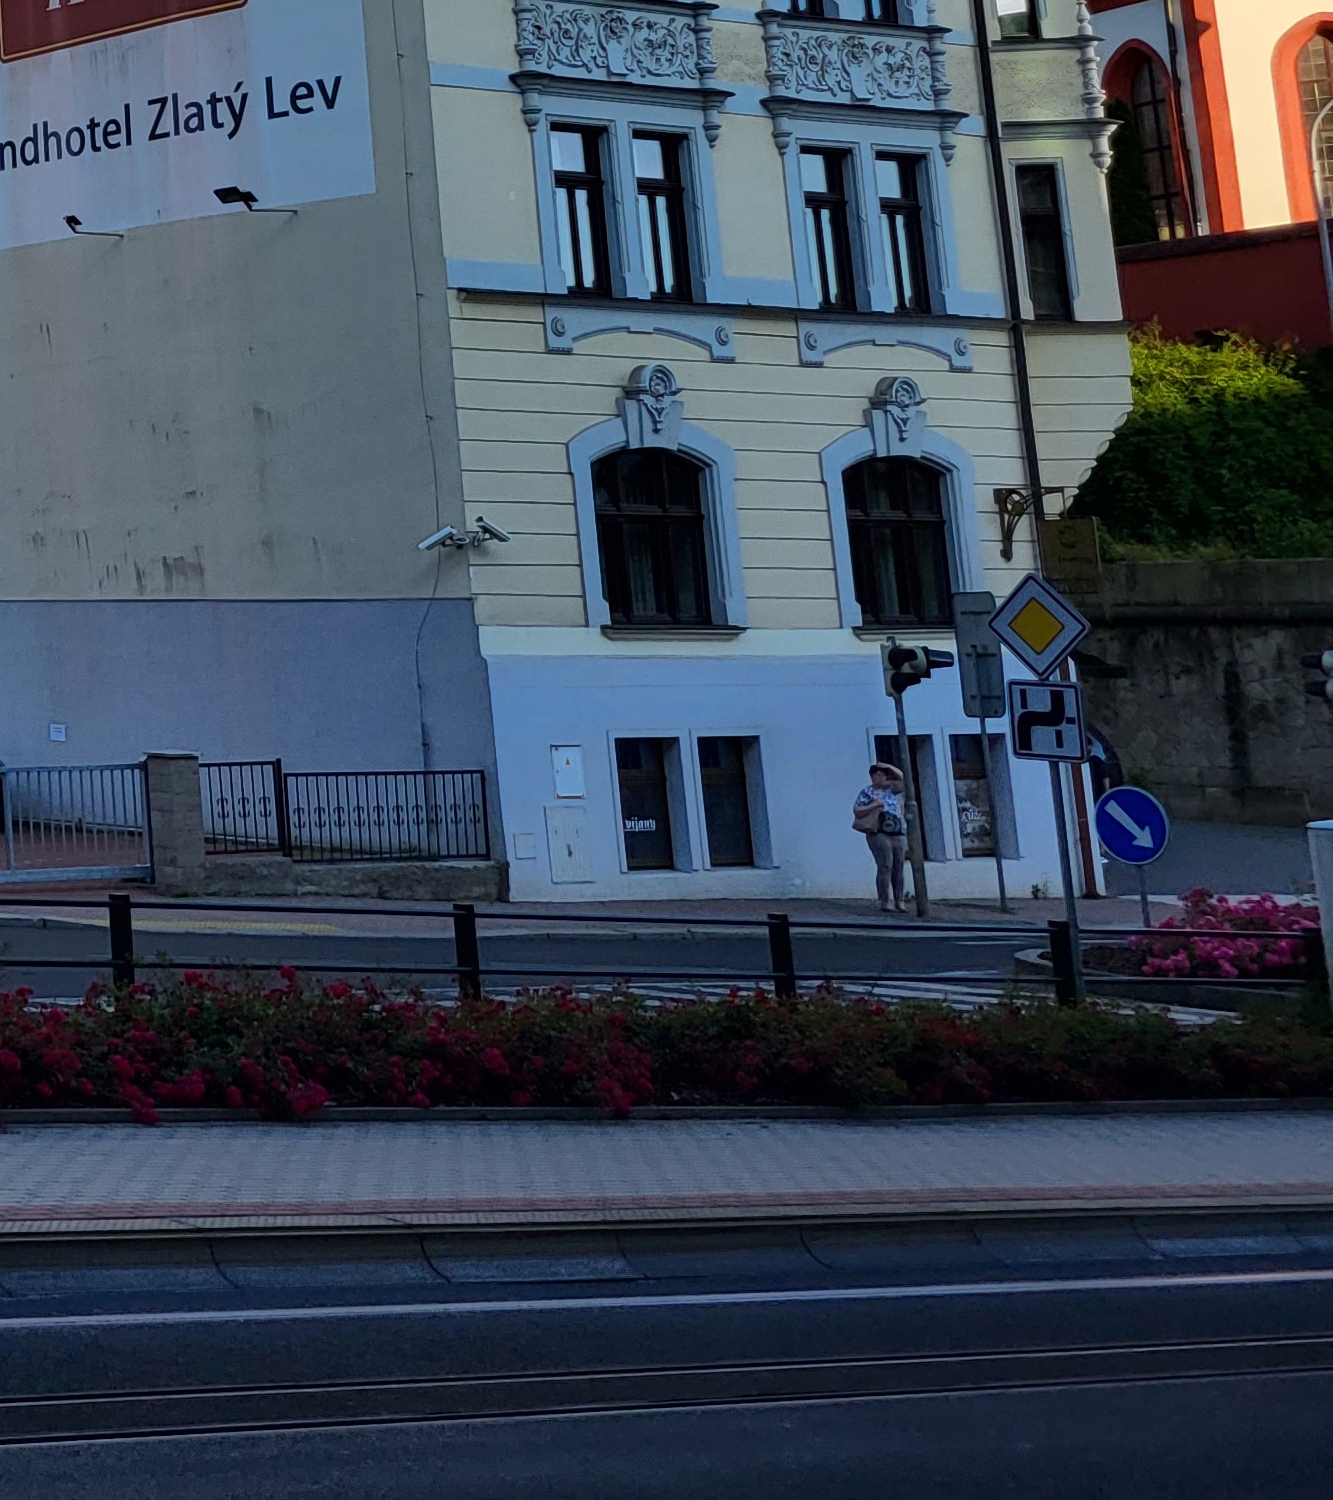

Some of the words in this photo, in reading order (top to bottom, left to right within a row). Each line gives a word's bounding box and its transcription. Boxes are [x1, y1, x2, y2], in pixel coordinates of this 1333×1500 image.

[147, 80, 249, 141] Zlatý
[264, 74, 342, 120] Lev
[624, 816, 656, 831] vijany
